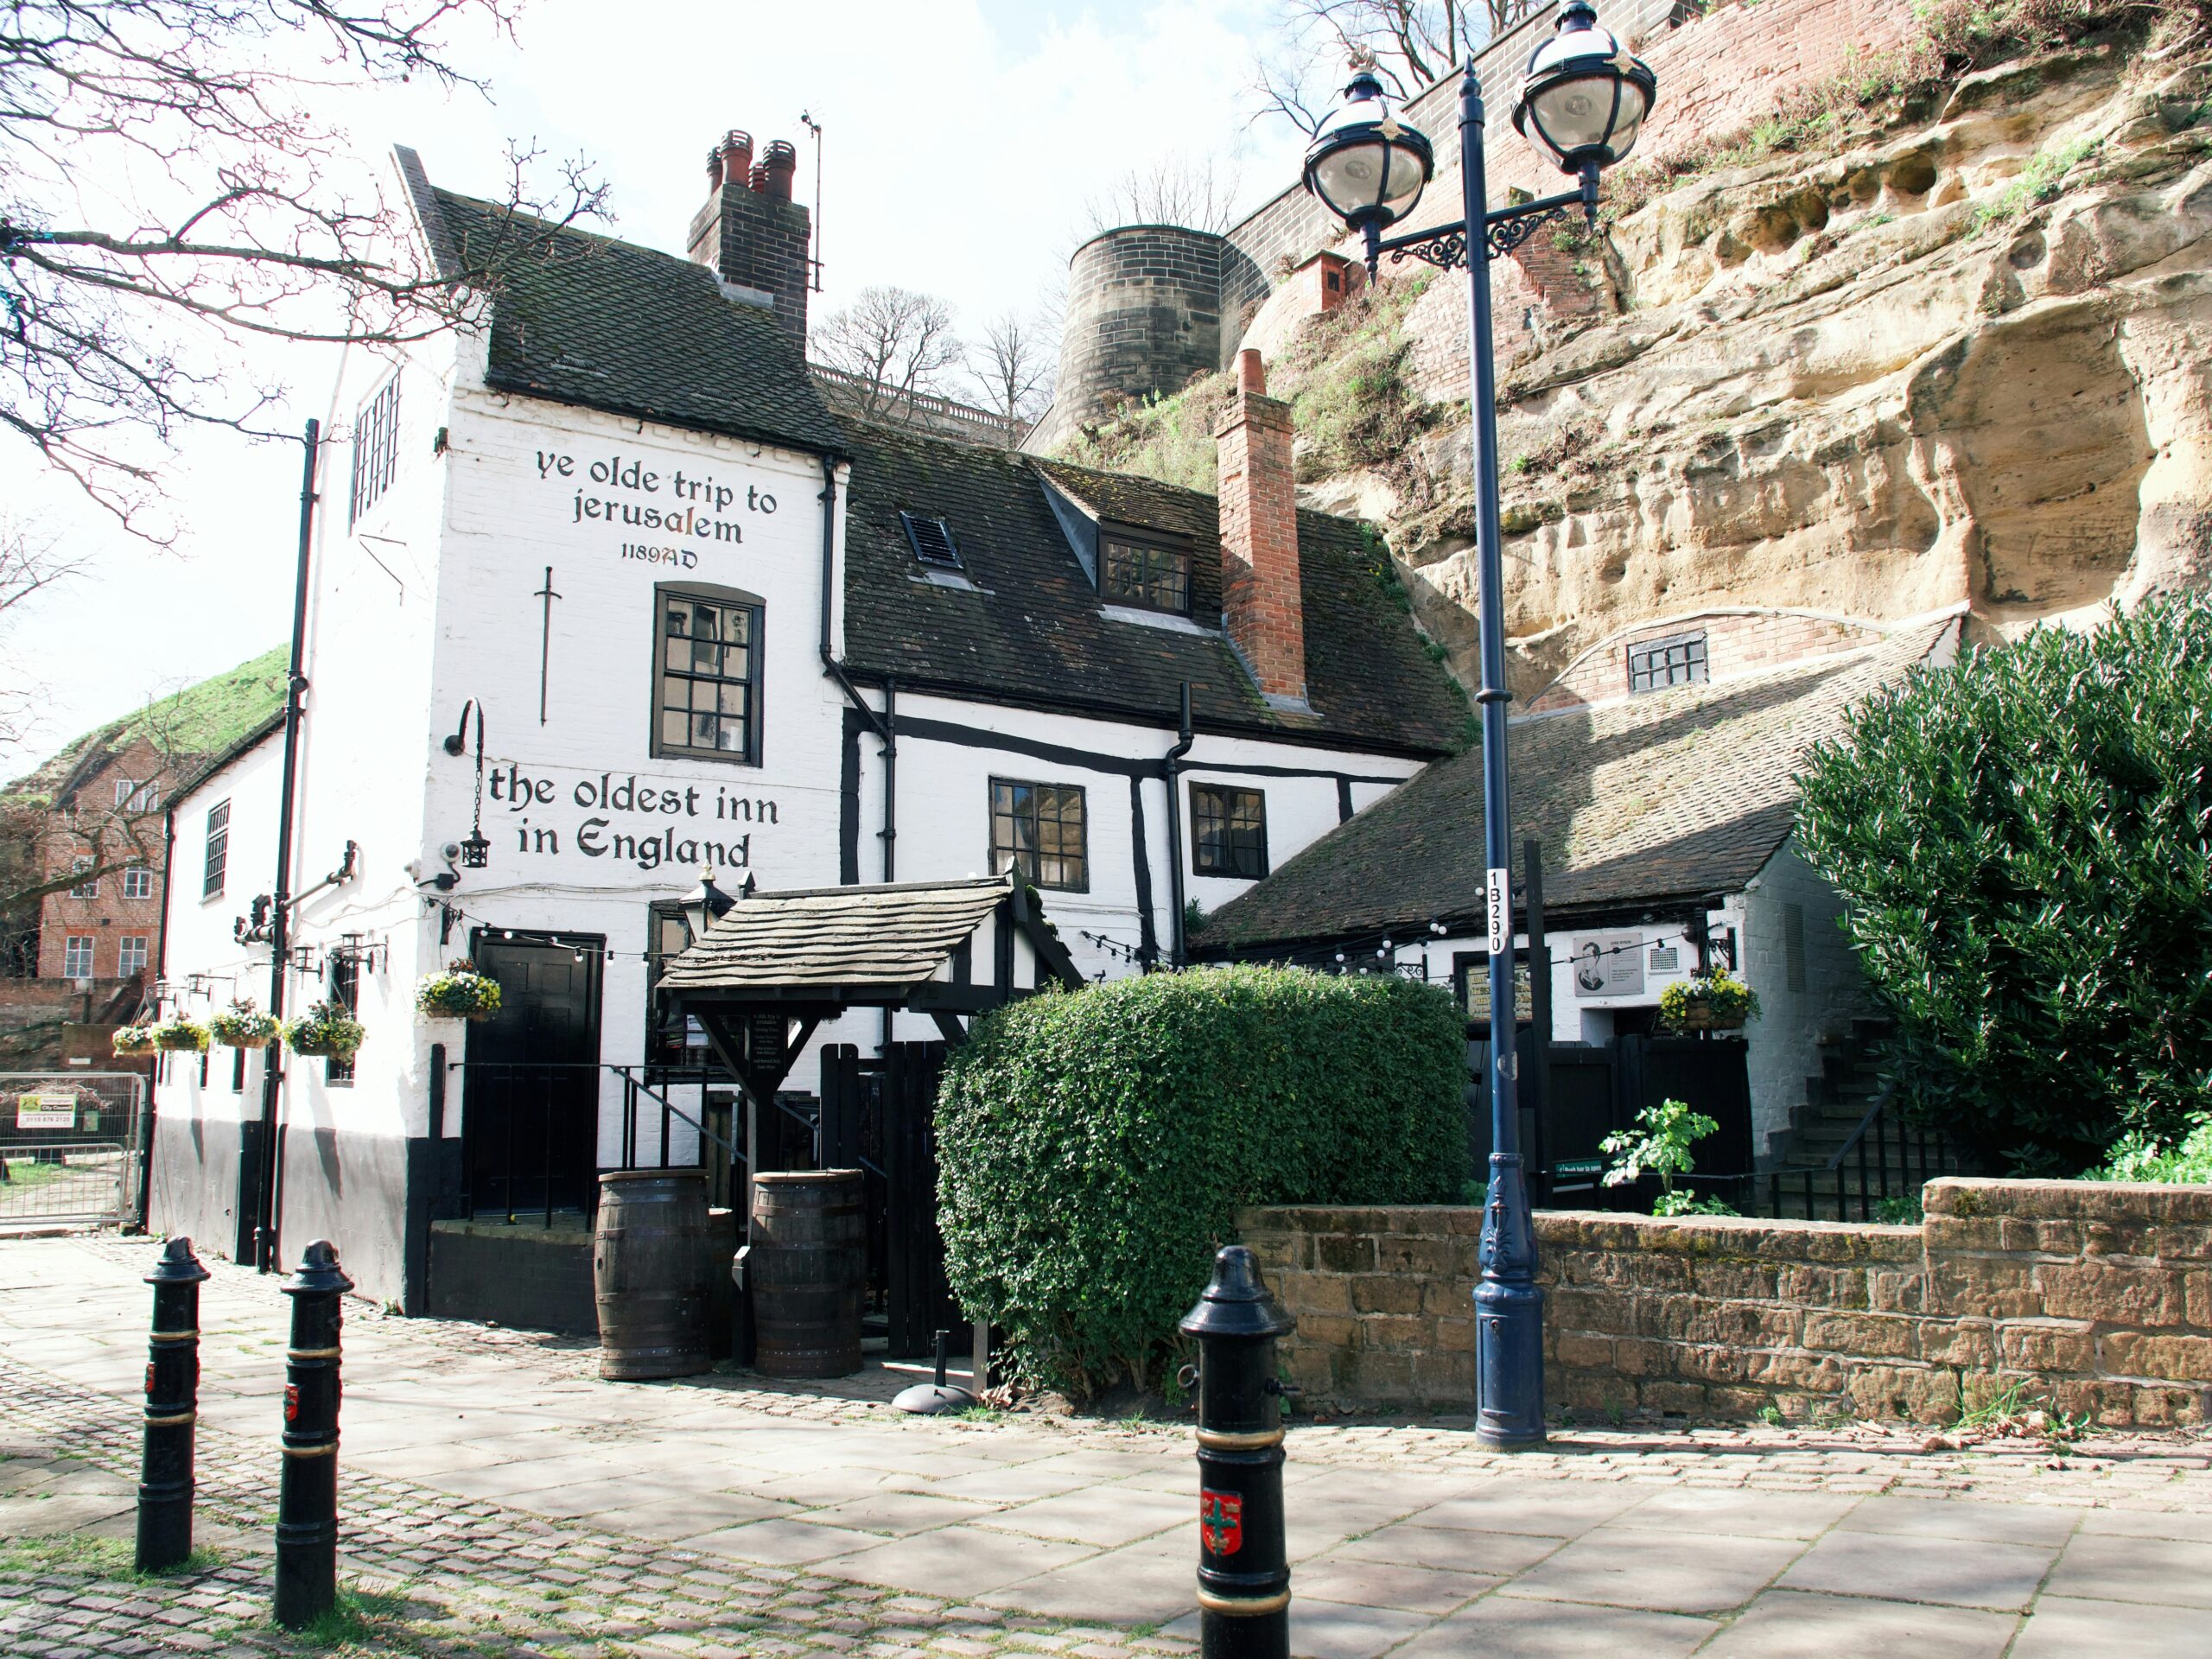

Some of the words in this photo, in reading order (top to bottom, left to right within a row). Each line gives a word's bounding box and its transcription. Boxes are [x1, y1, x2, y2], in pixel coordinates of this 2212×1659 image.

[537, 450, 575, 480] ye
[590, 456, 659, 493] olde
[674, 471, 734, 513] trip
[747, 485, 778, 514] to
[573, 488, 743, 544] jerusalem
[621, 543, 698, 569] 1189AD
[489, 764, 556, 812] the
[574, 772, 701, 817] oldest
[716, 786, 779, 825] inn
[518, 817, 559, 855] in
[576, 817, 751, 870] England
[1491, 872, 1501, 951] 1B290
